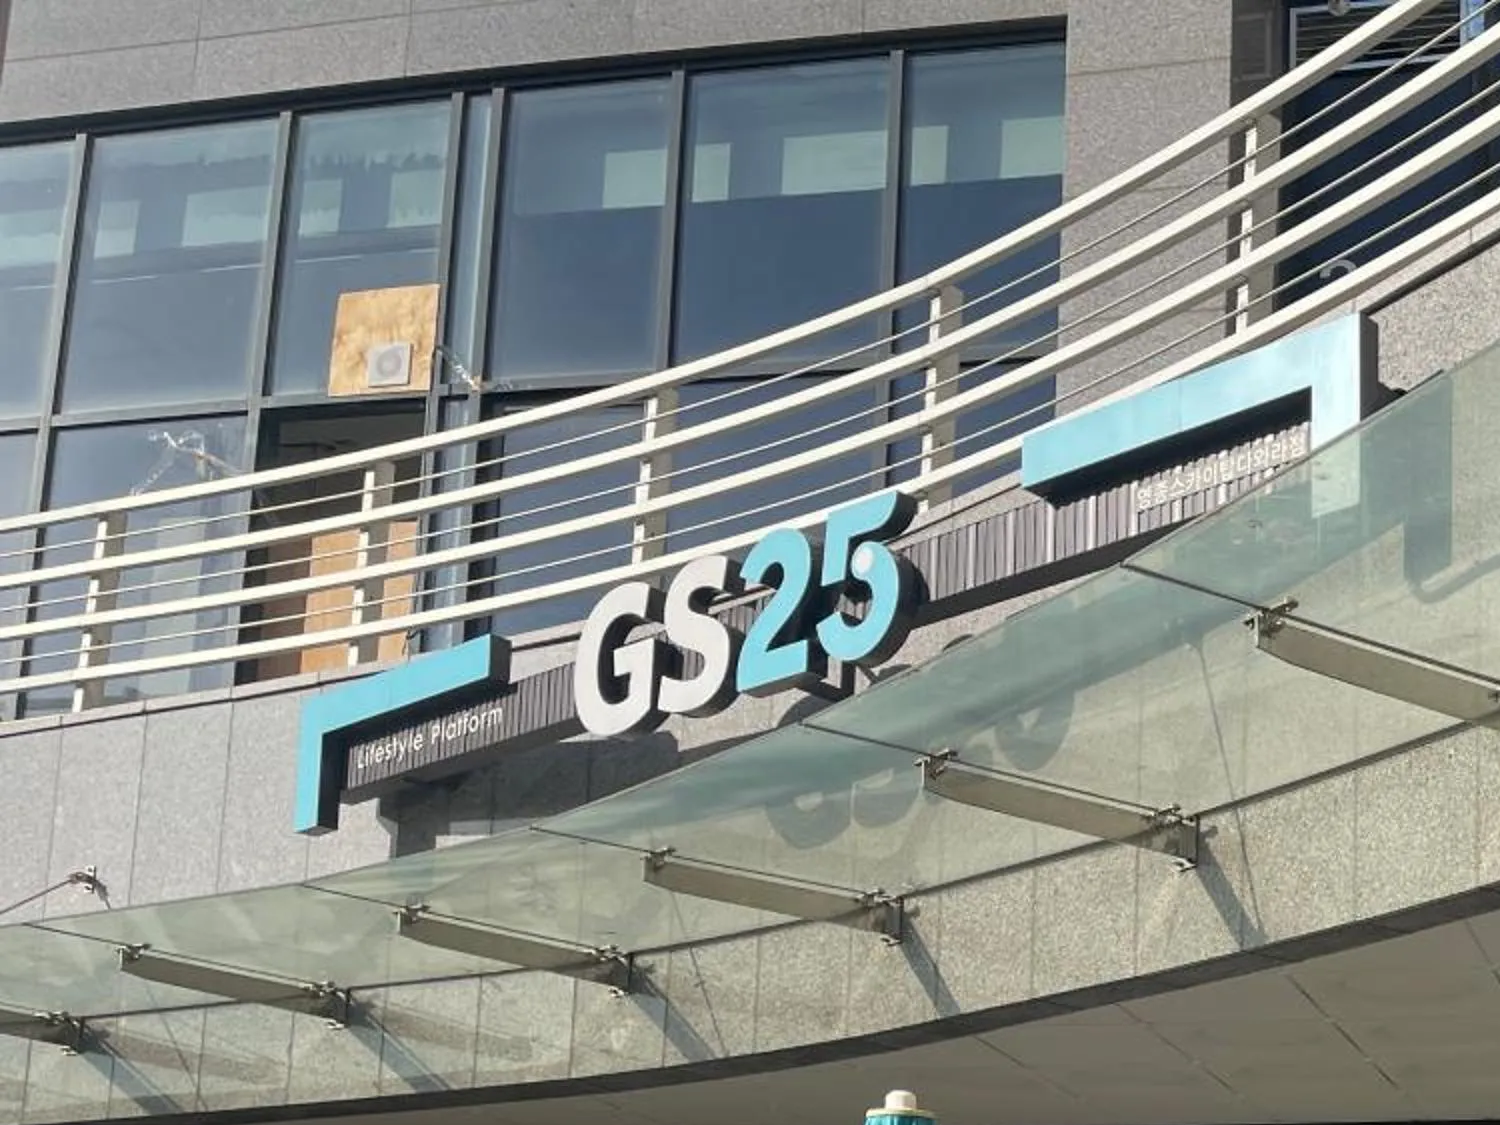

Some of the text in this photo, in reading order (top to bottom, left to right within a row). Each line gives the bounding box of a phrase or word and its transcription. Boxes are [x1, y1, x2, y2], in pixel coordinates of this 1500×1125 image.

[574, 489, 903, 737] GS25
[357, 706, 504, 769] Lifestyle Platform
